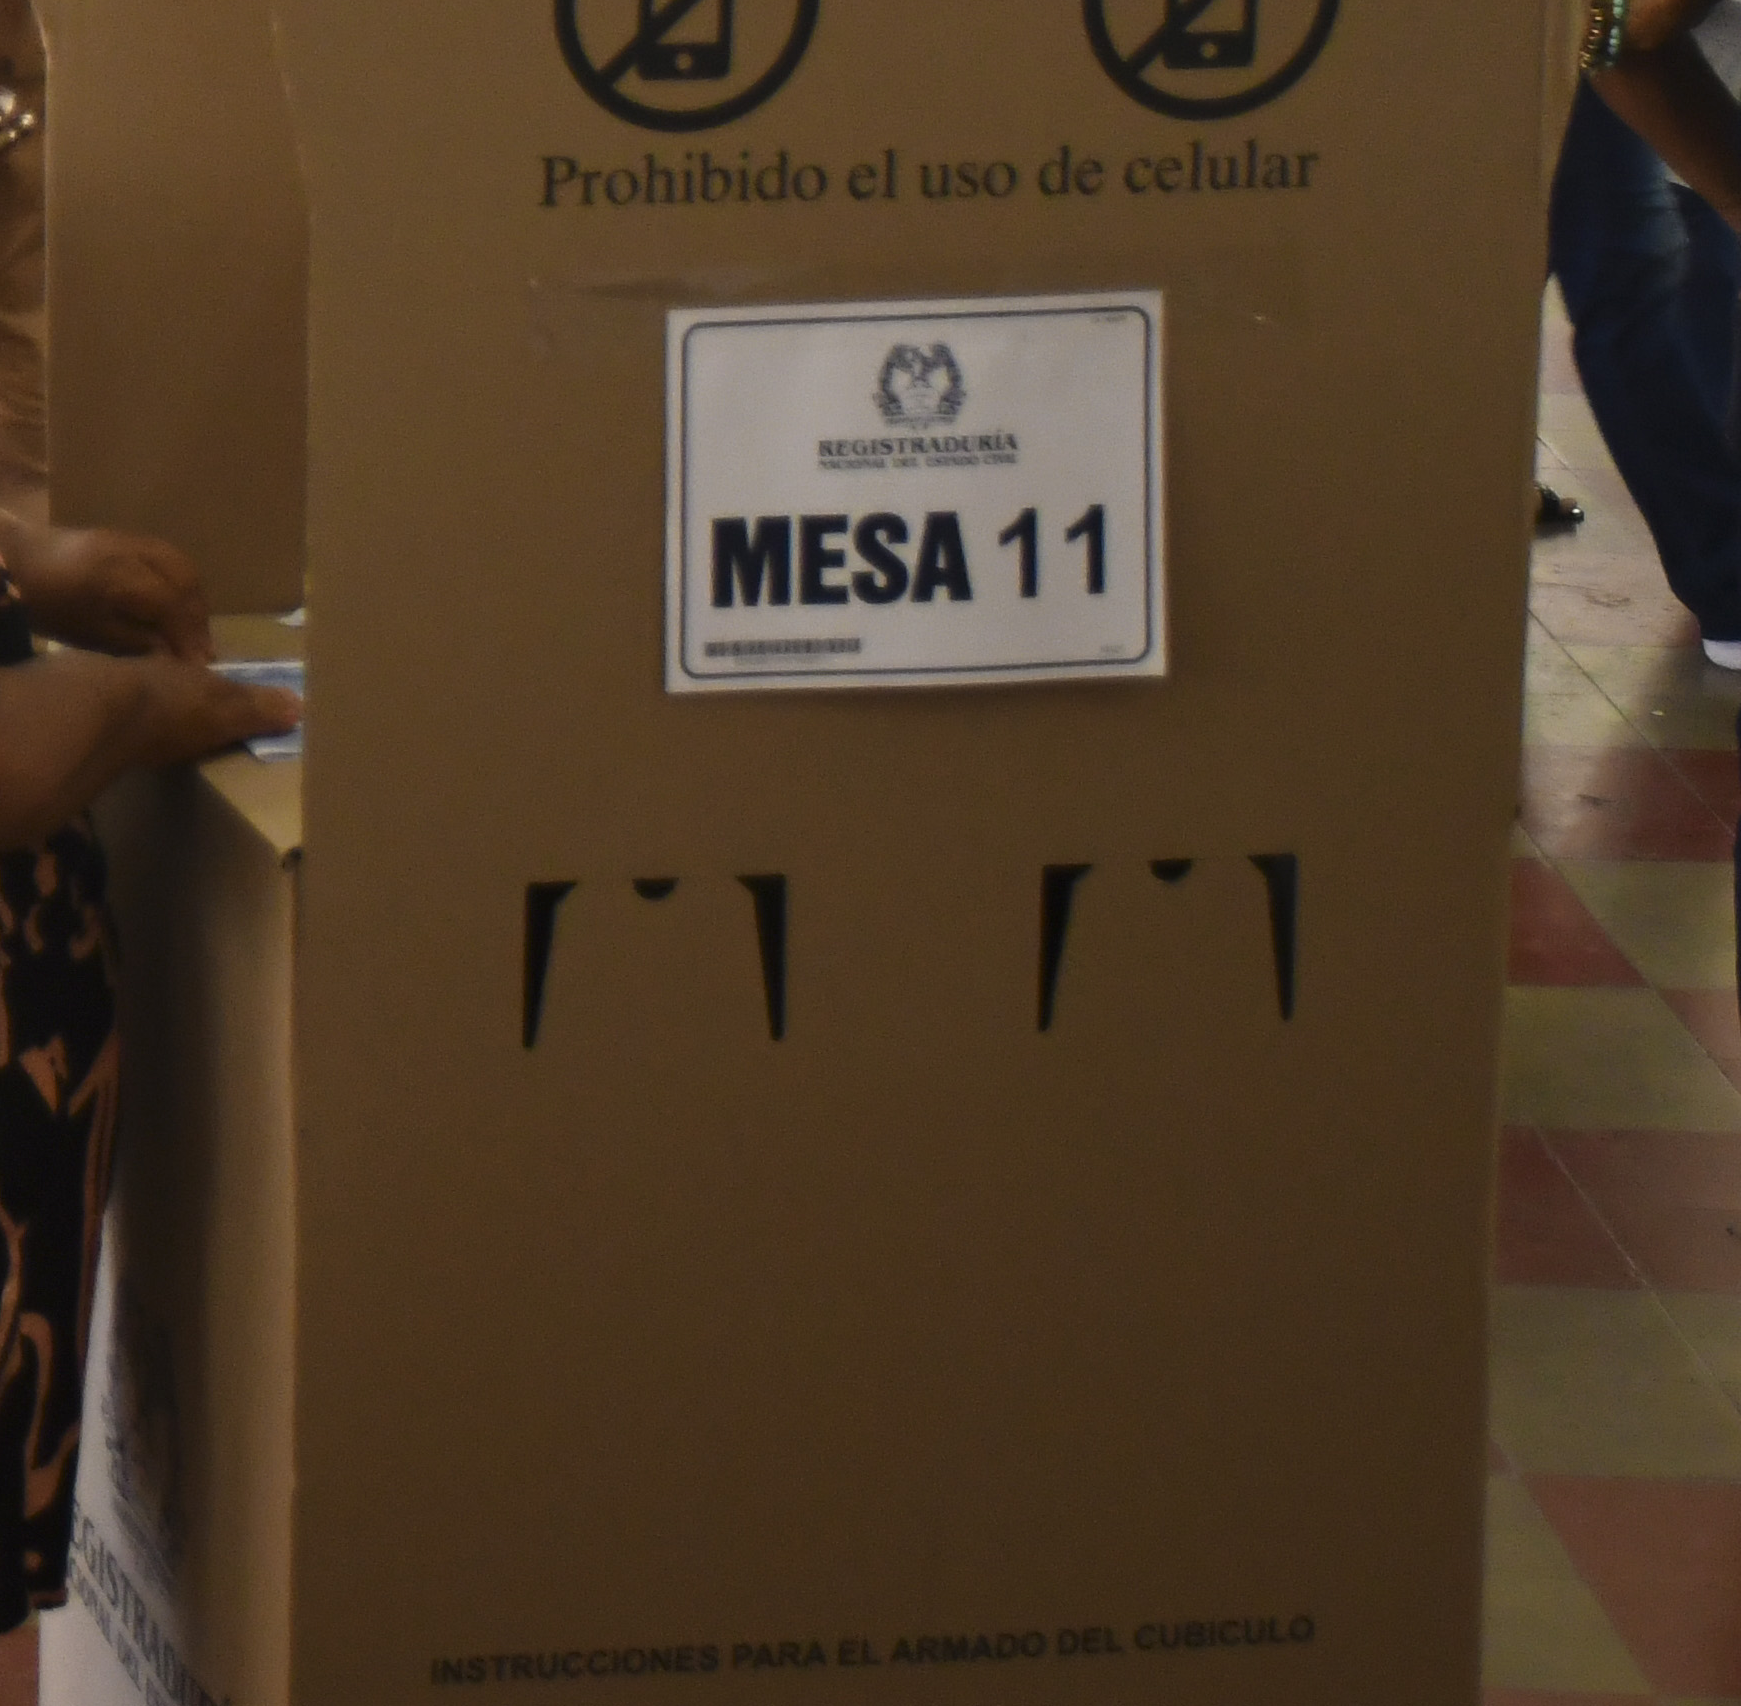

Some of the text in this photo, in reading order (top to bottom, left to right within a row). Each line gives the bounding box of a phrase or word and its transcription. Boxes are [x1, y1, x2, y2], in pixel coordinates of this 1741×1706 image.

[538, 138, 1318, 207] Prohibido el uso de celular
[711, 503, 1105, 608] MESA 11
[430, 1613, 1317, 1685] INSTRUCCIONES PARA EL ARMADO DEL CUBICULO
